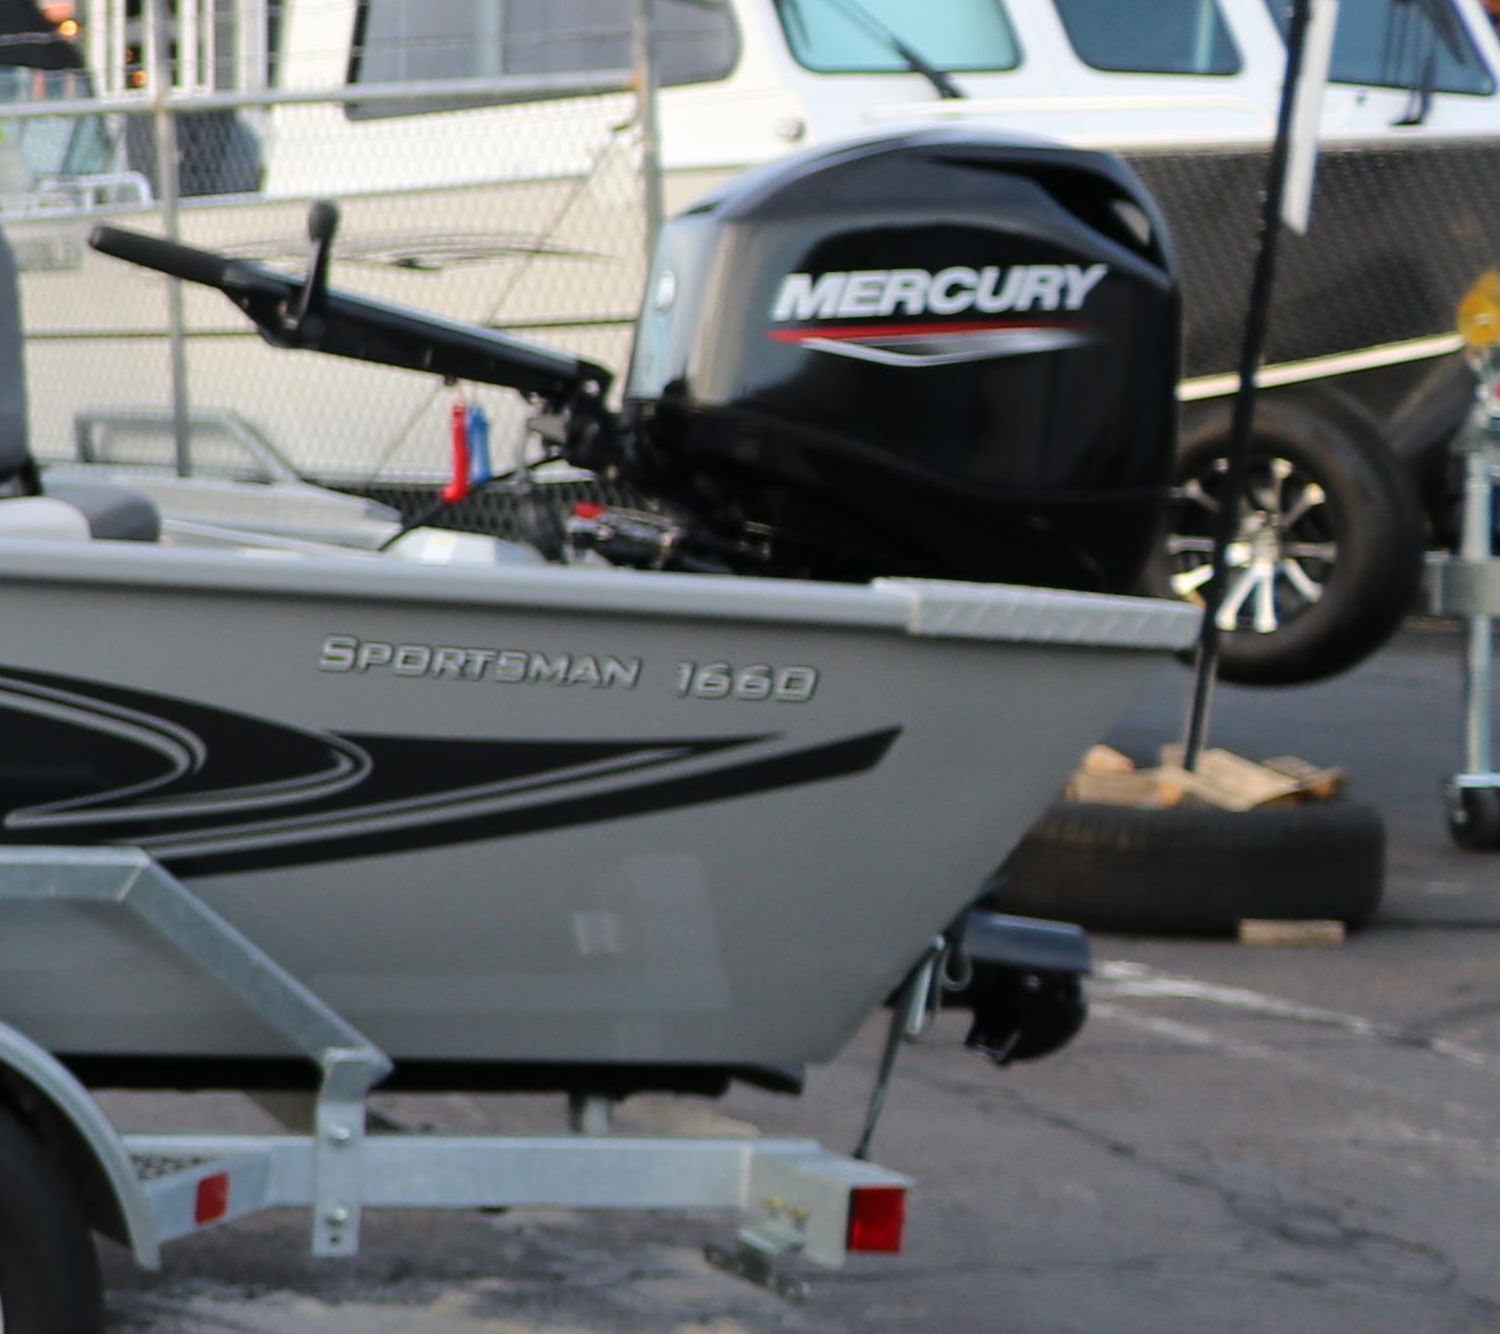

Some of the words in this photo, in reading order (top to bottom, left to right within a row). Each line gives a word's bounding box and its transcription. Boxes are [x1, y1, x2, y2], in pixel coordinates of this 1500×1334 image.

[771, 264, 1108, 321] MERCURY
[318, 634, 642, 690] SPORTSMAN
[675, 662, 819, 703] 1660
